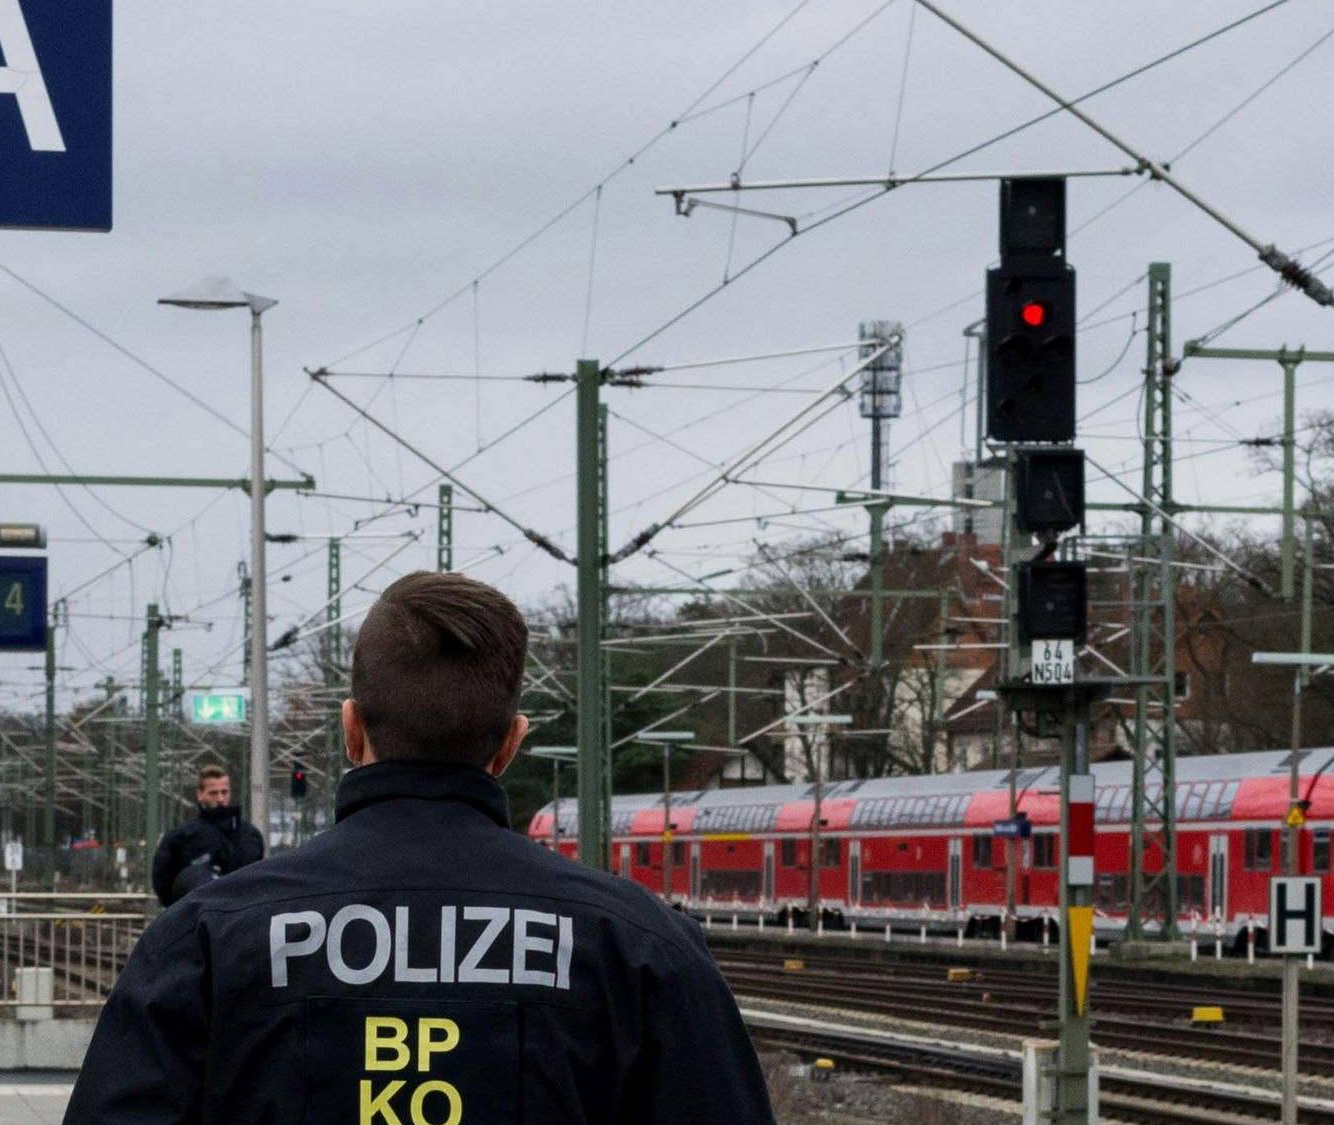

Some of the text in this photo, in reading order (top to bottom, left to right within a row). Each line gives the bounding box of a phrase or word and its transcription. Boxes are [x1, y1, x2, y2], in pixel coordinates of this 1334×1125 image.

[5, 581, 24, 615] 4
[1034, 662, 1071, 681] N504
[1276, 883, 1315, 946] H
[270, 904, 574, 990] POLIZEI
[365, 1017, 460, 1072] BP
